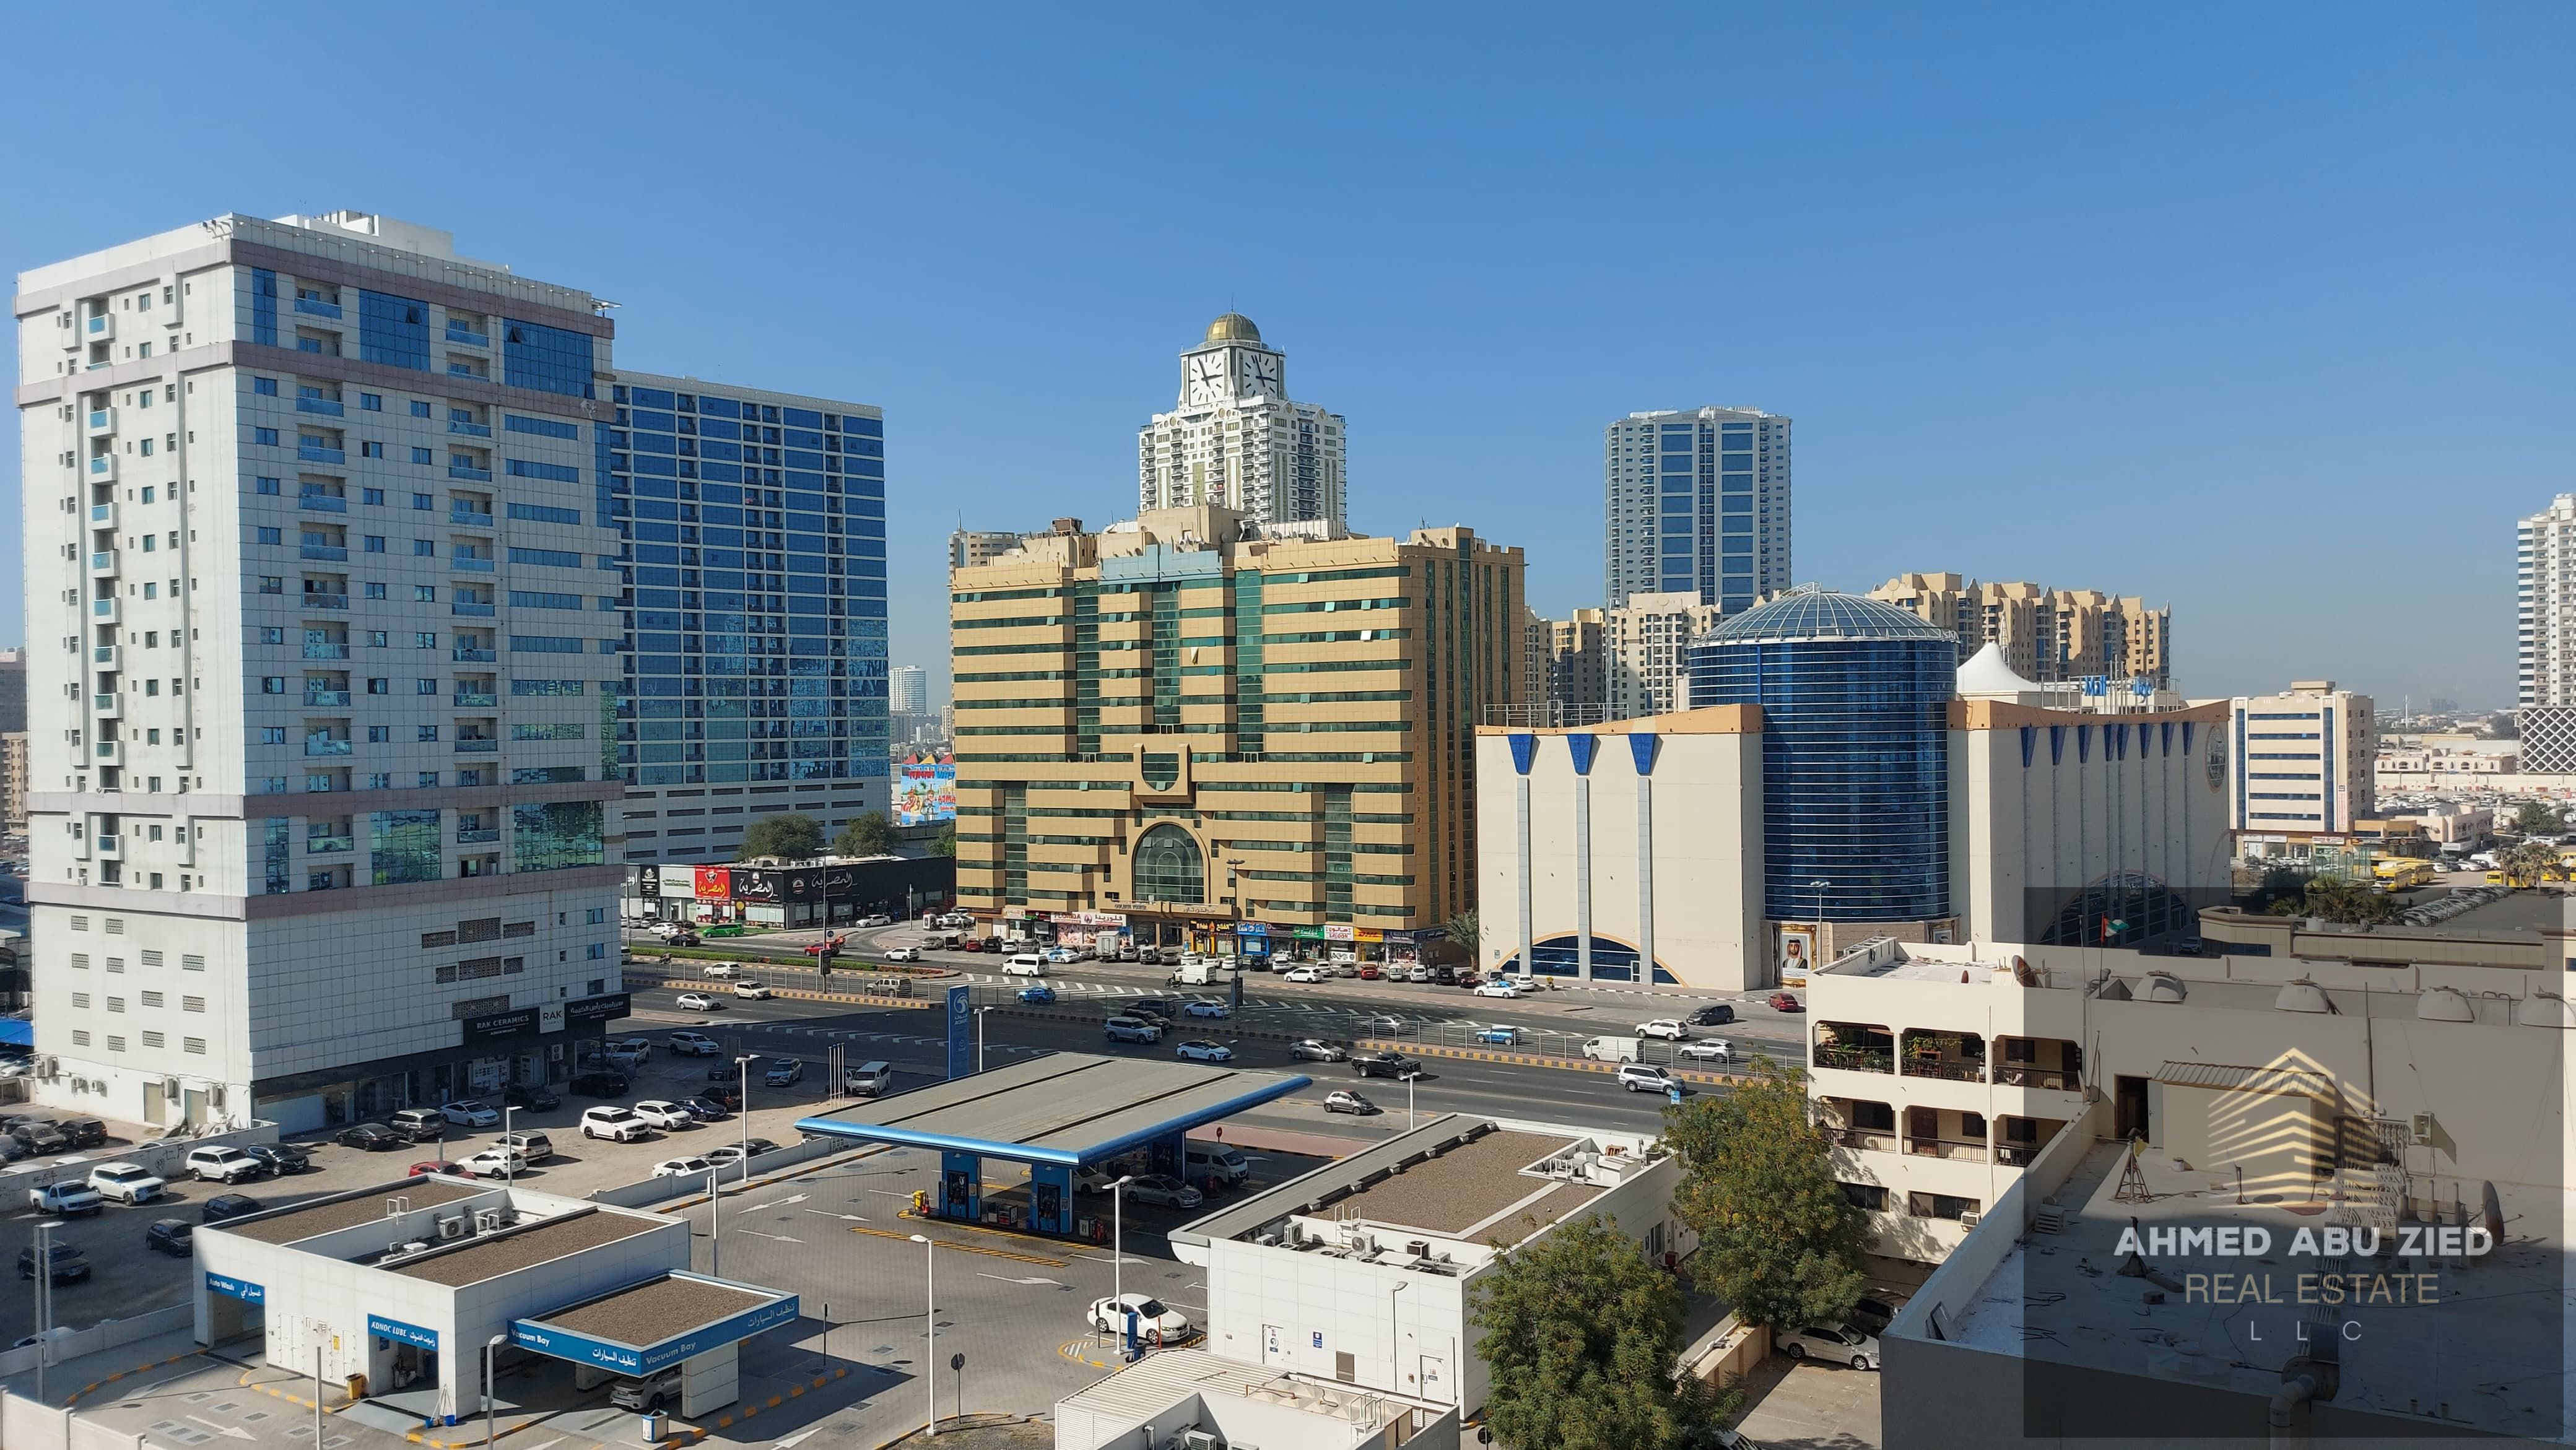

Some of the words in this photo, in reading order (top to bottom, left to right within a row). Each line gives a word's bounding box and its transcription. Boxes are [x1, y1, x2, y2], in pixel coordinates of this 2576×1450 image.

[739, 876, 774, 898] المصرية
[493, 1015, 529, 1027] CERAMICS
[543, 1010, 562, 1021] RAK
[776, 1303, 794, 1317] تنظيف
[747, 1309, 775, 1327] السيارات
[372, 1321, 391, 1333] ADNOC
[393, 1327, 407, 1337] LUBE
[511, 1328, 536, 1342] Vacuum
[536, 1335, 550, 1347] Bay
[592, 1348, 617, 1361] السيارات
[618, 1354, 637, 1366] تنظيف
[646, 1348, 679, 1365] Vacuum
[681, 1342, 696, 1353] Bay
